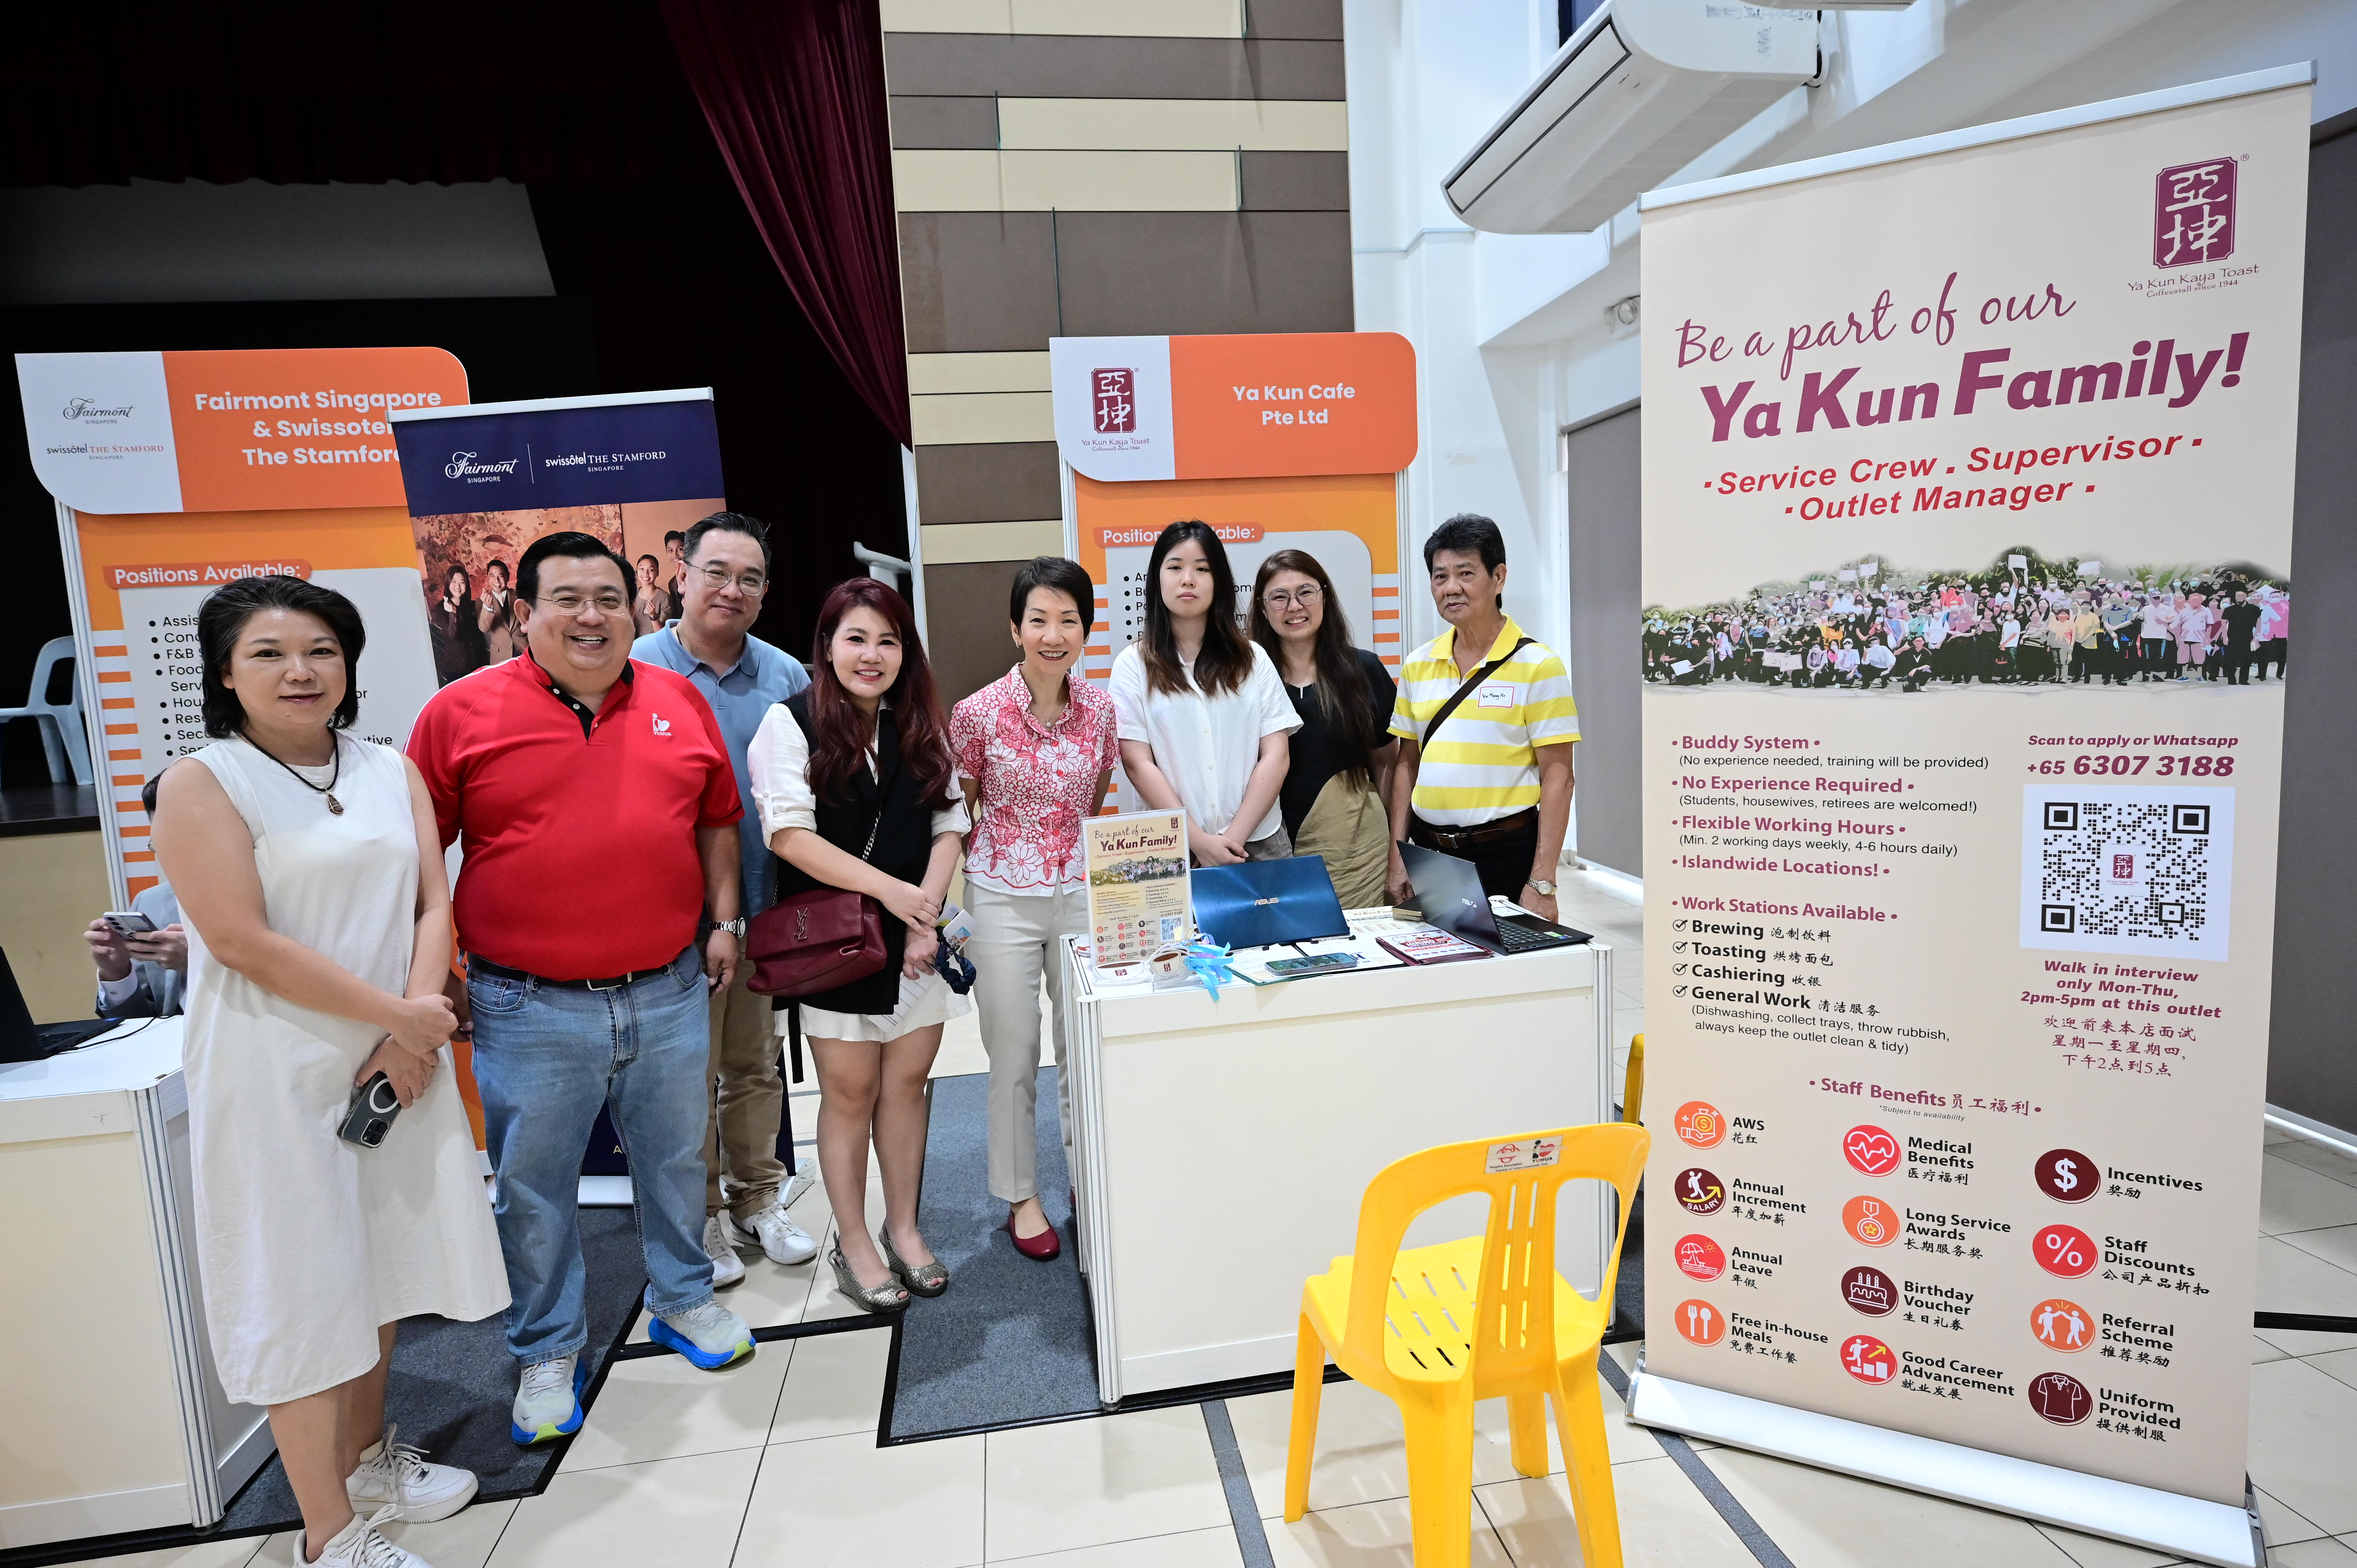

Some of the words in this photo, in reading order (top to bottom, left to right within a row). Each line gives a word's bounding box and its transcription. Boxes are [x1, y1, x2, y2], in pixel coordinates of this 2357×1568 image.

[2128, 282, 2143, 291] Ya
[2148, 279, 2175, 289] Kun
[2180, 273, 2216, 287] Kaya
[2219, 264, 2259, 277] Toast
[2147, 285, 2191, 297] Coffeestall
[1675, 319, 1733, 368] Be
[1744, 331, 1774, 357] a
[1780, 289, 1897, 381] part
[1911, 272, 1957, 346] of
[1980, 283, 2076, 325] our
[1232, 386, 1259, 401] Ya
[1264, 385, 1304, 400] Kun
[1308, 383, 1355, 399] Cafe
[1700, 380, 1781, 442] Ya
[1796, 367, 1940, 433] Kun
[1953, 332, 2250, 415] Family!
[62, 397, 136, 420] Fairmont
[195, 391, 311, 410] Fairmont
[315, 389, 441, 413] Singapore
[1262, 410, 1294, 425] Pte
[1299, 408, 1328, 424] Ltd
[253, 420, 272, 437] &
[47, 443, 88, 454] swissôtel
[1109, 439, 1128, 448] Kaya
[242, 448, 288, 465] The
[445, 451, 519, 479] Fairmont
[545, 451, 586, 467] swissôtel
[587, 455, 609, 464] THE
[612, 451, 666, 462] STAMFORD
[1717, 465, 1836, 494] Service
[1850, 458, 1938, 483] Crew
[1967, 435, 2183, 475] Supervisor
[1800, 491, 1902, 521] Outlet
[1912, 482, 2073, 512] Manager
[1103, 528, 1162, 543] Position
[115, 567, 198, 584] Positions
[166, 648, 194, 659] F&B
[1683, 735, 1739, 752] Buddy
[1744, 735, 1809, 753] System
[2028, 735, 2065, 745] Scan
[2068, 735, 2084, 745] to
[2087, 735, 2131, 748] apply
[2154, 735, 2239, 748] Whatsapp
[2027, 760, 2065, 775] +65
[2074, 755, 2150, 775] 6307
[2156, 756, 2234, 777] 3188
[1683, 776, 1706, 789] No
[1712, 776, 1810, 793] Experience
[1816, 777, 1902, 795] Required
[1095, 830, 1105, 839] Be
[1112, 826, 1130, 842] part
[1132, 824, 1138, 837] of
[1683, 815, 1750, 830] Flexible
[1754, 817, 1832, 836] Working
[1838, 819, 1894, 835] Hours
[1100, 840, 1114, 851] Ya
[1116, 838, 1138, 850] Kun
[1140, 835, 1177, 847] Family!
[1683, 855, 1778, 872] Islandwide
[1783, 859, 1878, 877] Locations!
[1254, 897, 1279, 906] ASUS
[1681, 896, 1726, 911] Work
[1729, 899, 1798, 915] Stations
[1802, 903, 1885, 922] Available
[1693, 920, 1763, 940] Brewing
[1771, 927, 1831, 943] 泡制饮料
[1691, 942, 1766, 963] Toasting
[1773, 951, 1833, 966] 烘烤面包
[1692, 964, 1785, 987] Cashiering
[1792, 974, 1822, 987] 收银
[2044, 960, 2087, 973] Walk
[2093, 963, 2108, 975] in
[2115, 964, 2199, 982] interview
[2057, 978, 2092, 992] only
[2098, 980, 2179, 999] Mon-Thu,
[1692, 986, 1759, 1004] General
[1763, 992, 1811, 1009] Work
[1818, 999, 1880, 1017] 清洁服务
[2021, 991, 2095, 1008] 2pm-5pm
[2102, 998, 2121, 1009] at
[2127, 999, 2160, 1012] this
[2167, 1005, 2222, 1018] outlet
[1821, 1078, 1863, 1096] Staff
[1871, 1084, 1946, 1107] Benefits
[1952, 1094, 2029, 1116] 员工福利
[1733, 1117, 1764, 1131] AWS
[1923, 1112, 1965, 1122] availability
[1732, 1132, 1758, 1144] 花红
[1908, 1136, 1971, 1154] Medical
[1908, 1151, 1974, 1169] Benefits
[1908, 1167, 1968, 1185] 医疗福利
[2108, 1167, 2203, 1192] Incentives
[1733, 1178, 1783, 1196] Annual
[2106, 1184, 2141, 1199] 奖励
[1687, 1198, 1719, 1211] SALARY
[1732, 1191, 1807, 1214] Increment
[1731, 1206, 1785, 1226] 年度加薪
[1904, 1281, 1974, 1306] Birthday
[1904, 1294, 1971, 1316] Voucher
[1903, 1311, 1964, 1331] 生日礼券
[2099, 1388, 2174, 1413] Uniform
[2099, 1403, 2181, 1430] Provided
[2096, 1418, 2167, 1442] 提供制服
